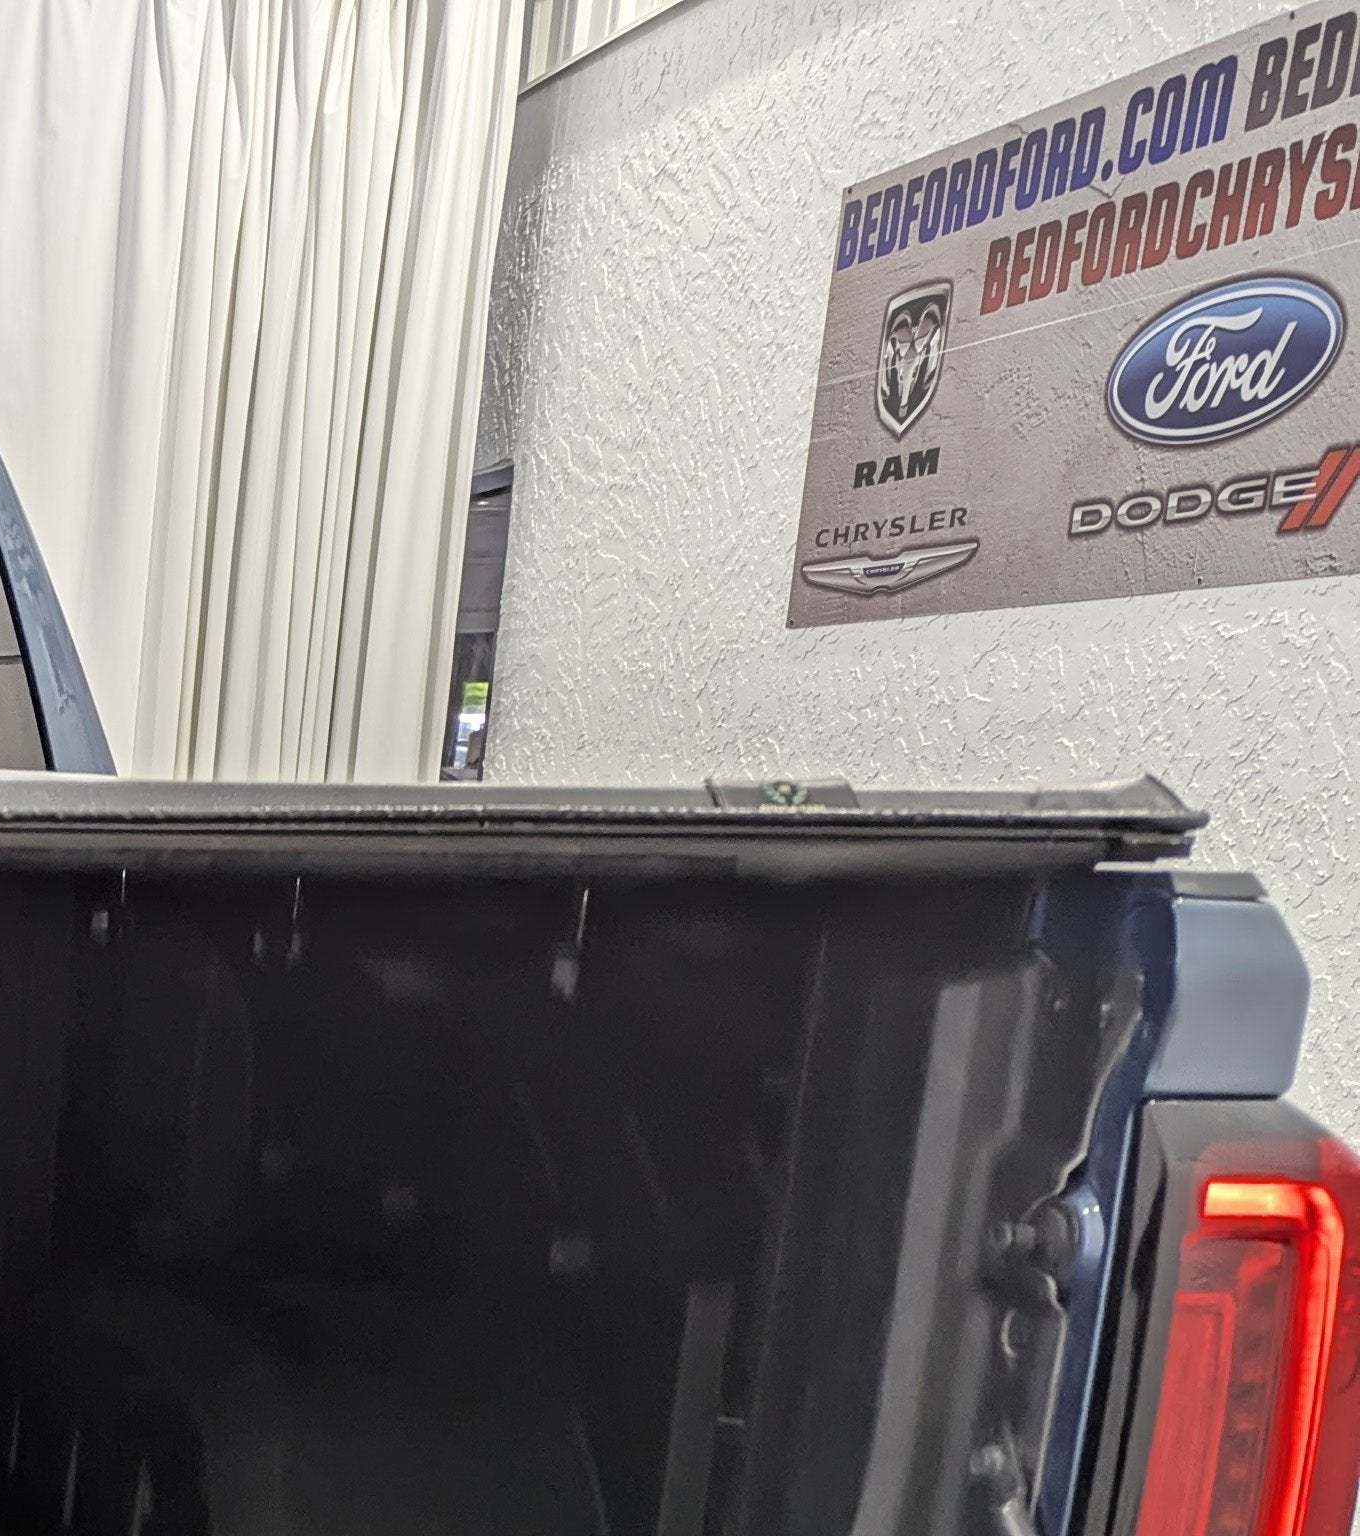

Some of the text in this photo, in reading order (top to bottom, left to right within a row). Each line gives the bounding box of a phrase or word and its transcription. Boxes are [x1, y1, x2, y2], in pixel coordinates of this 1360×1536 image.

[837, 55, 1238, 271] BEDFORDFORD.COM
[1146, 308, 1299, 420] Ford
[853, 447, 940, 489] RAM
[815, 507, 968, 548] CHRYSLER
[1070, 469, 1320, 534] DODGE
